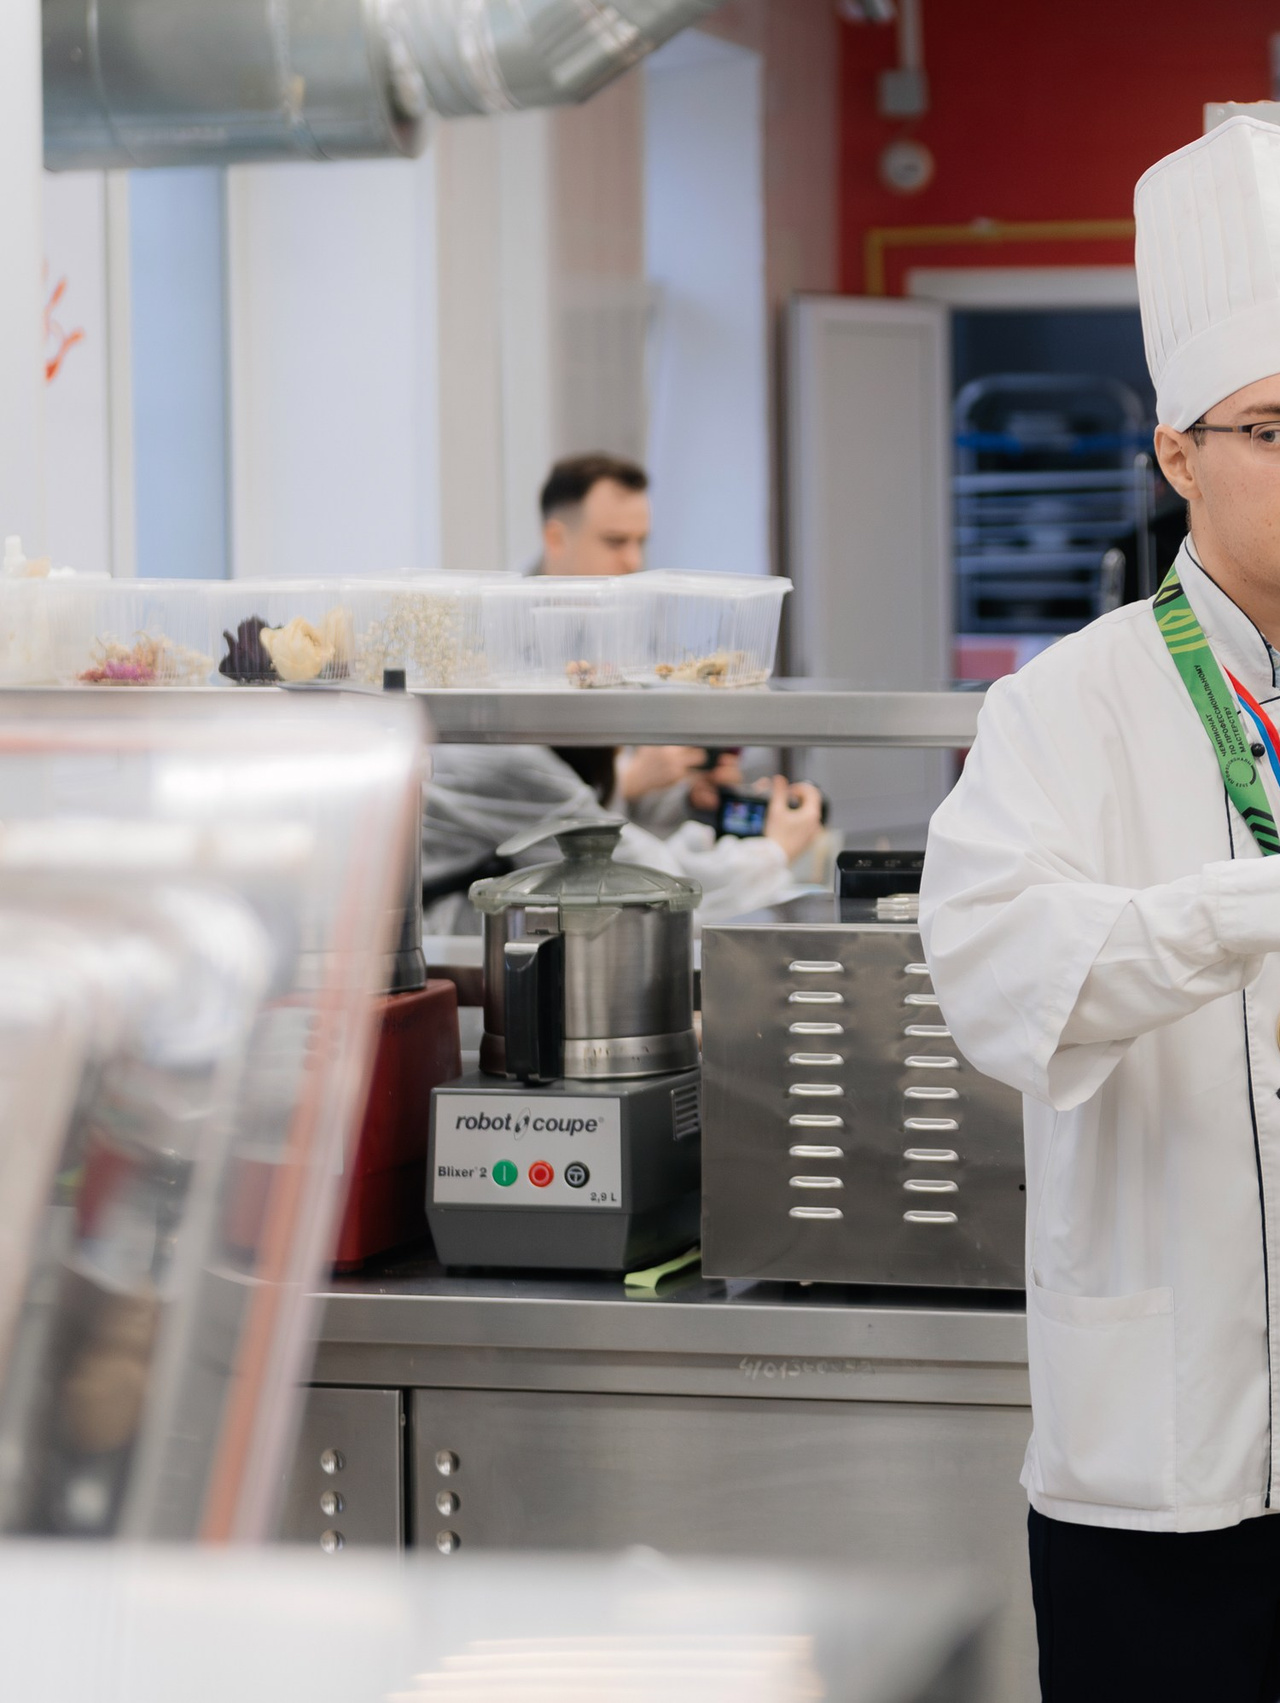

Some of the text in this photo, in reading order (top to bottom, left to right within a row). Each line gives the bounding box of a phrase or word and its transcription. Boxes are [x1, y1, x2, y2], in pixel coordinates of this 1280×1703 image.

[1194, 664, 1237, 755] ПО ПРОФЕССИОНАЛЬНОМУ
[1205, 714, 1227, 757] ЧЕМПИОНАТ
[1223, 706, 1247, 753] МАСТЕРСТВУ
[455, 1112, 598, 1136] robot coupe
[437, 1166, 488, 1178] Blixer 2
[610, 1192, 617, 1202] L
